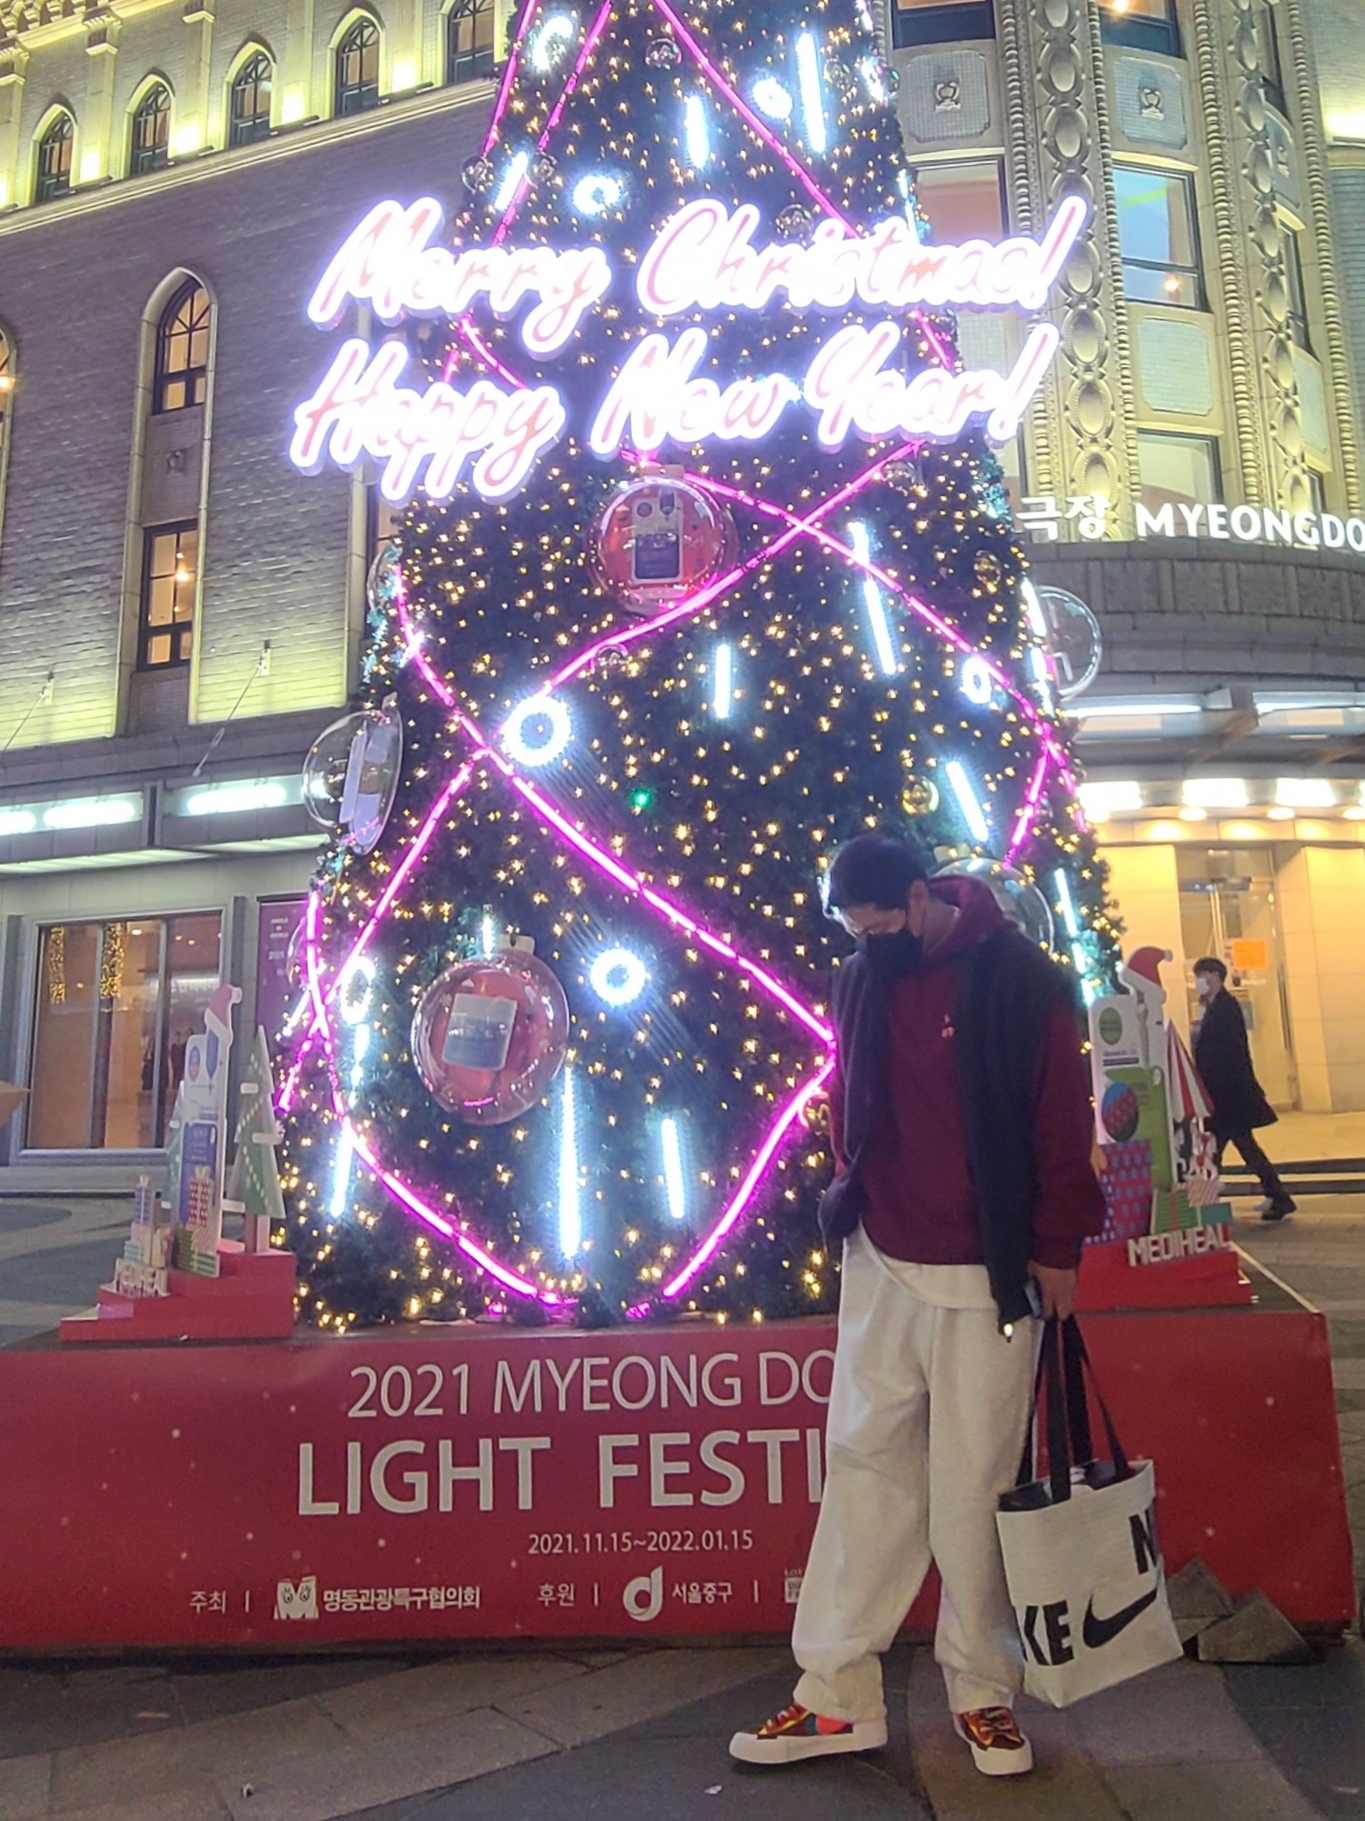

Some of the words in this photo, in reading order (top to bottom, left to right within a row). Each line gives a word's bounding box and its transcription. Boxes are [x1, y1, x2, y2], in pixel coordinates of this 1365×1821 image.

[307, 197, 611, 362] Merry
[636, 194, 1088, 318] Christmas!
[289, 338, 566, 501] Happy
[592, 326, 801, 456] New
[803, 321, 1060, 448] Year!
[1016, 494, 1110, 541] 극장
[1135, 502, 1365, 552] MYEONGDO
[1127, 1222, 1232, 1267] MEDIHEAL
[347, 1363, 471, 1418] 2021
[493, 1352, 742, 1414] MYEONG
[758, 1349, 836, 1406] DO
[298, 1437, 551, 1516] LIGHT
[598, 1428, 822, 1508] FESTI
[528, 1530, 753, 1555] 2021.11.15~2022.01.15
[189, 1591, 227, 1614] 주최
[323, 1586, 481, 1612] 명동관광특구협의회
[537, 1583, 576, 1607] 후원
[672, 1582, 733, 1604] 서울중구
